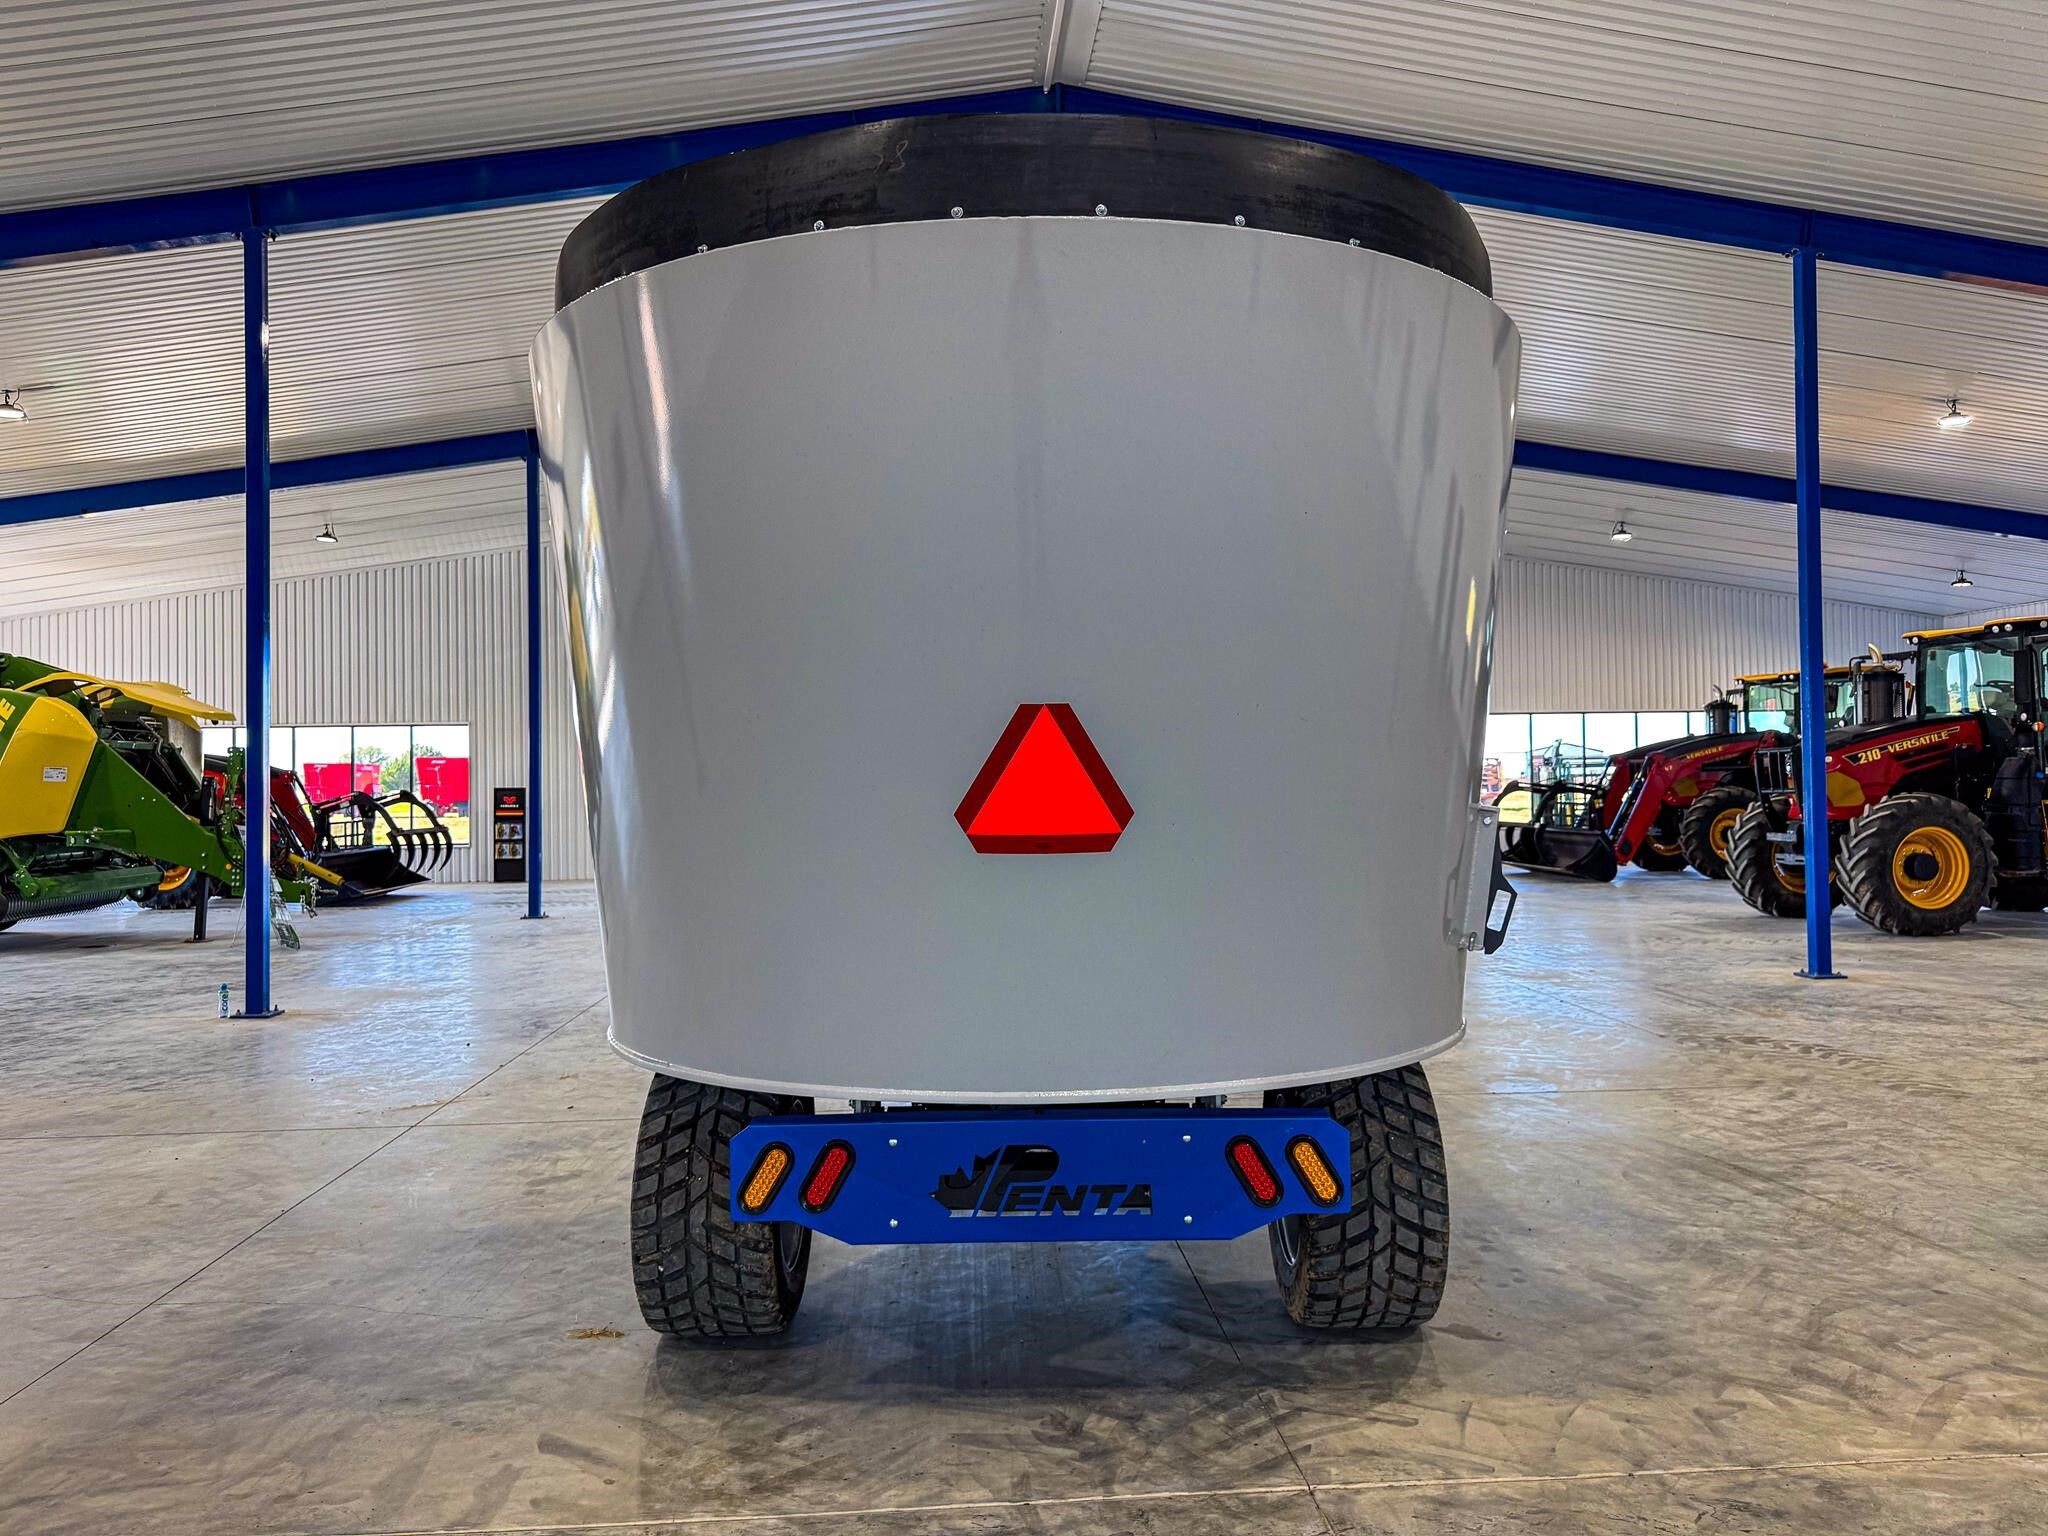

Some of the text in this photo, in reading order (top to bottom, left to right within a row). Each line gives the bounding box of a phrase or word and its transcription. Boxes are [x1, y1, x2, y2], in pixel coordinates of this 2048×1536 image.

[1686, 746, 1723, 759] VERSATILE
[1858, 730, 1949, 764] 210 VERSATILE
[976, 1144, 1153, 1217] PENTA
